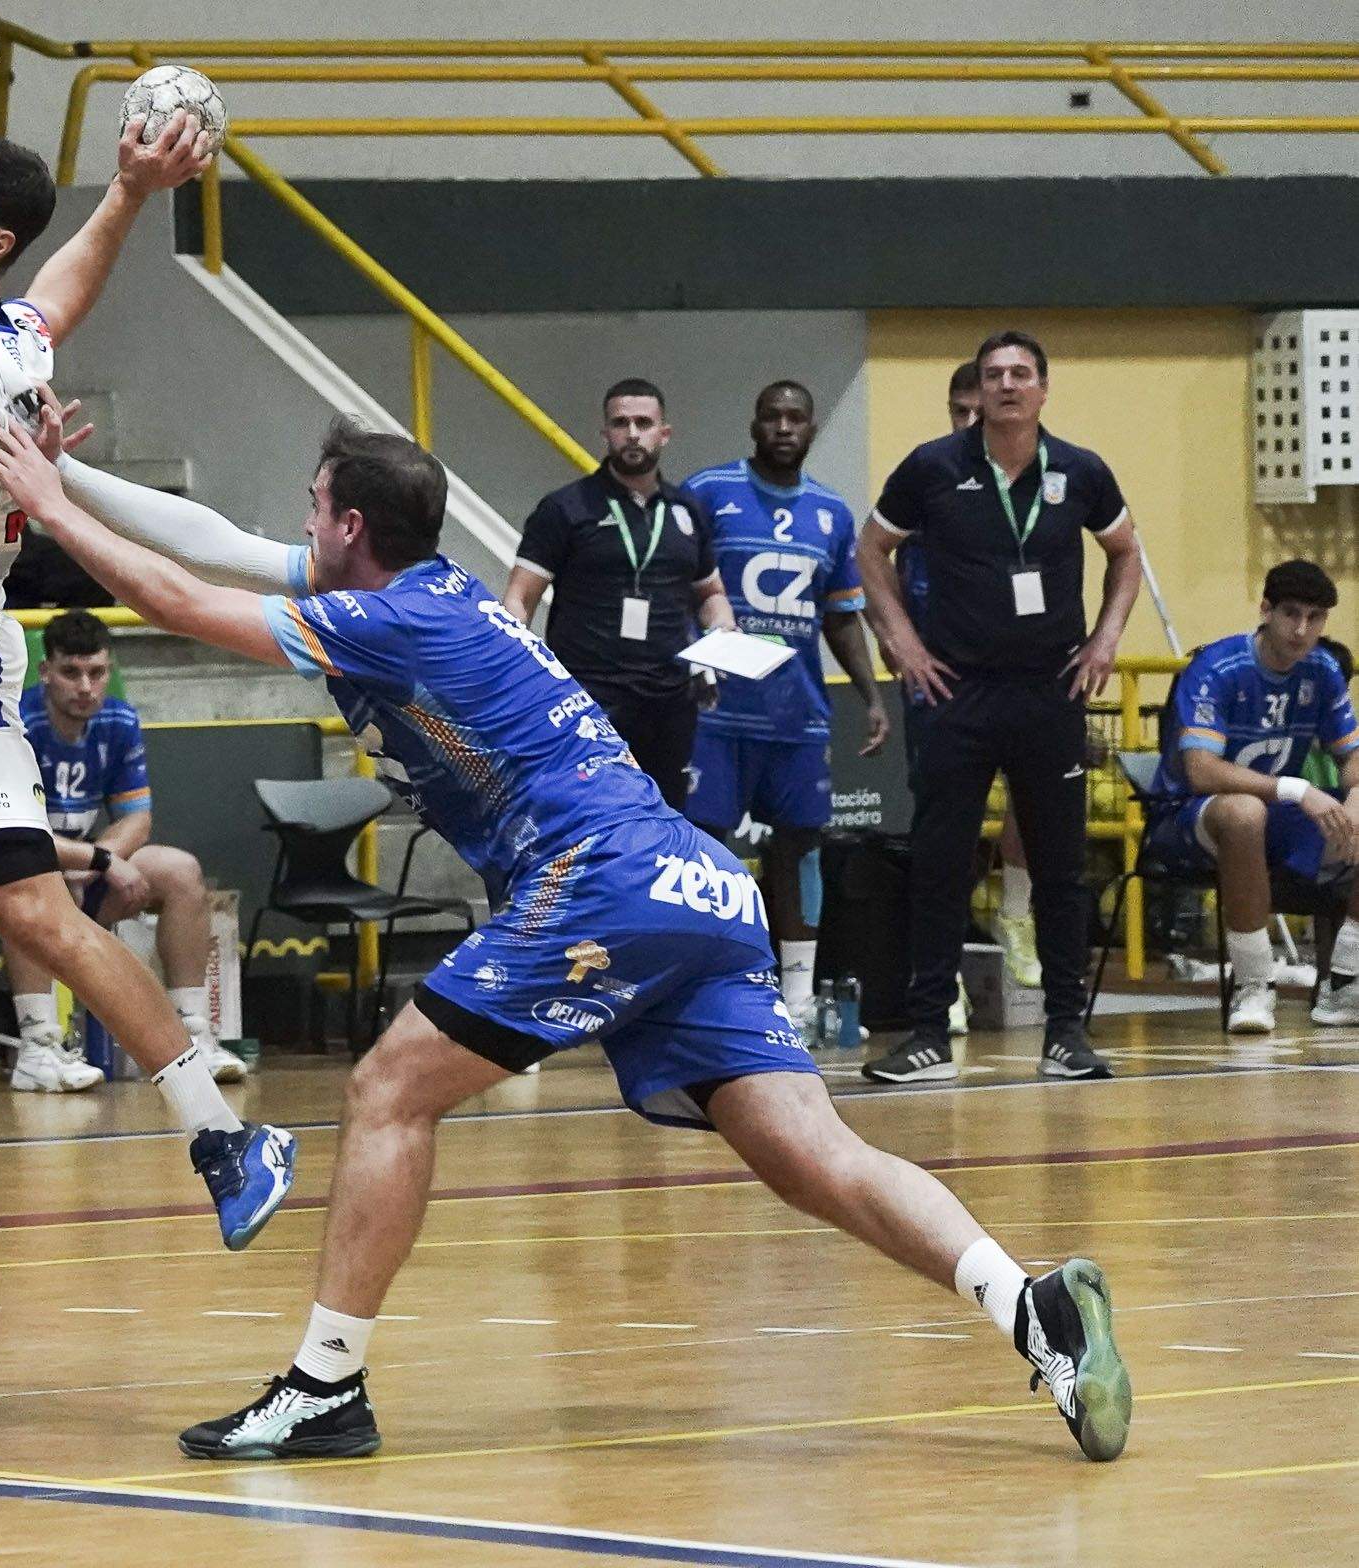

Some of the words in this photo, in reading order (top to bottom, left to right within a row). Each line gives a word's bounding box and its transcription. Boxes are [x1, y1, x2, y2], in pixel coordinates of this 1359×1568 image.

[773, 507, 794, 543] 2
[742, 552, 819, 618] CZ
[546, 1001, 606, 1033] BELLVIS
